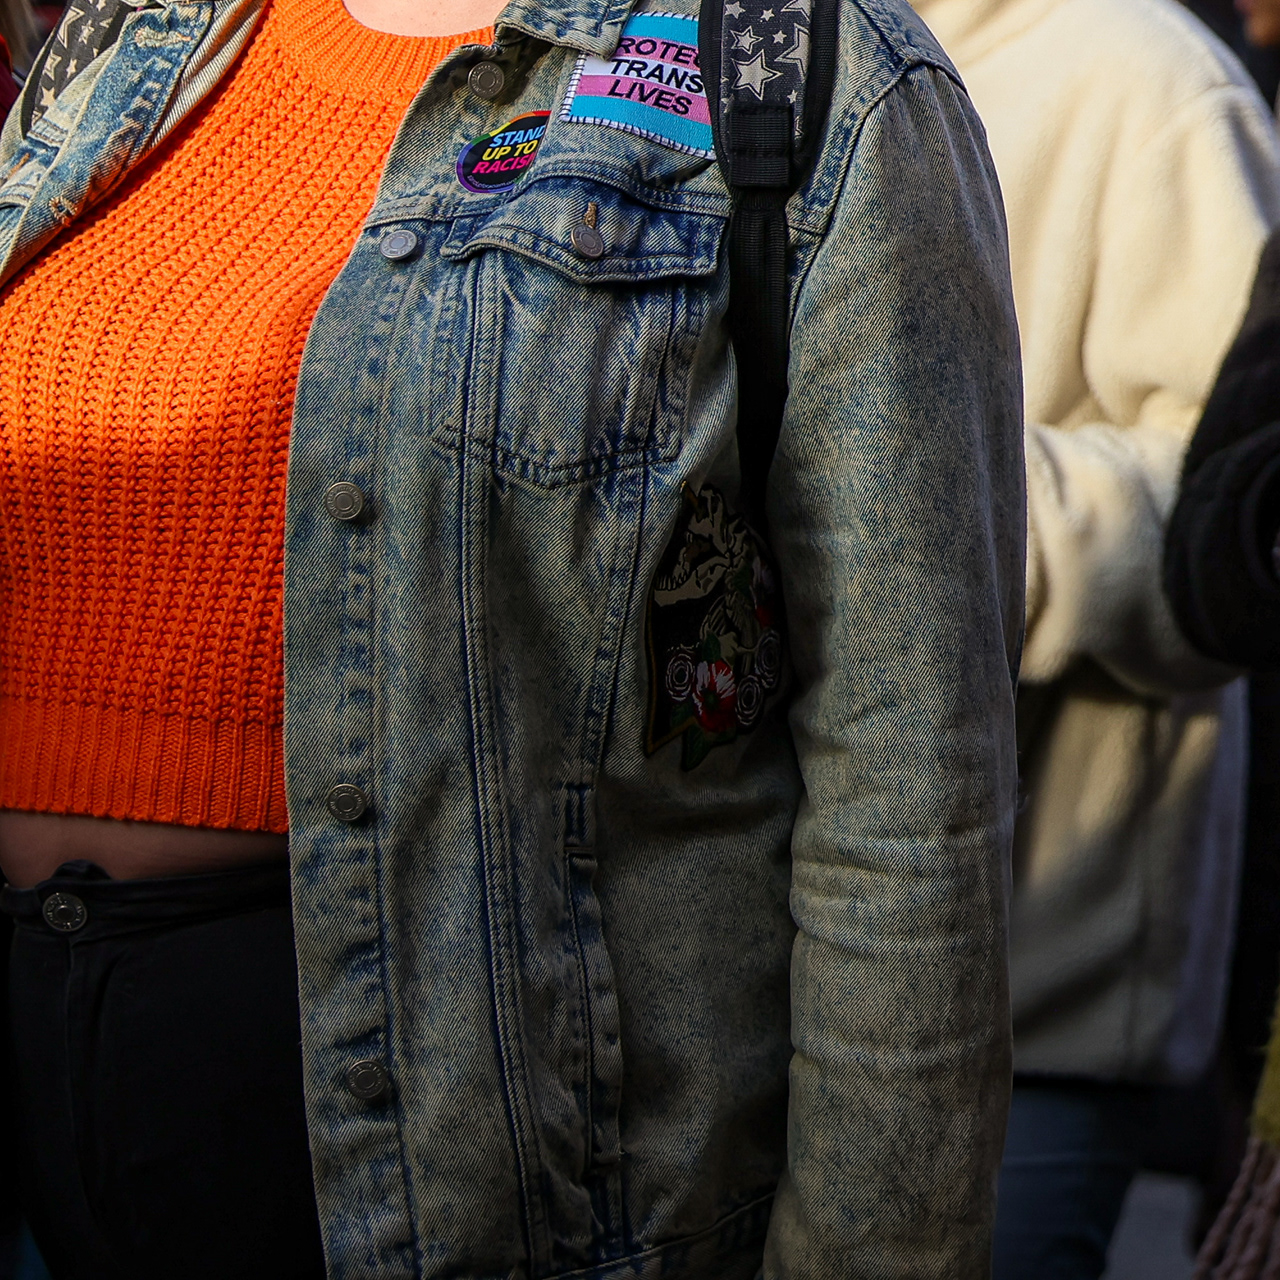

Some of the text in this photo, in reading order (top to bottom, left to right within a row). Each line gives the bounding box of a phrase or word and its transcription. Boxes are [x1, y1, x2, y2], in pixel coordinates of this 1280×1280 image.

[615, 37, 700, 68] ROTE
[611, 58, 704, 94] TRANS
[607, 79, 693, 115] LIVES
[482, 139, 538, 161] UP TO
